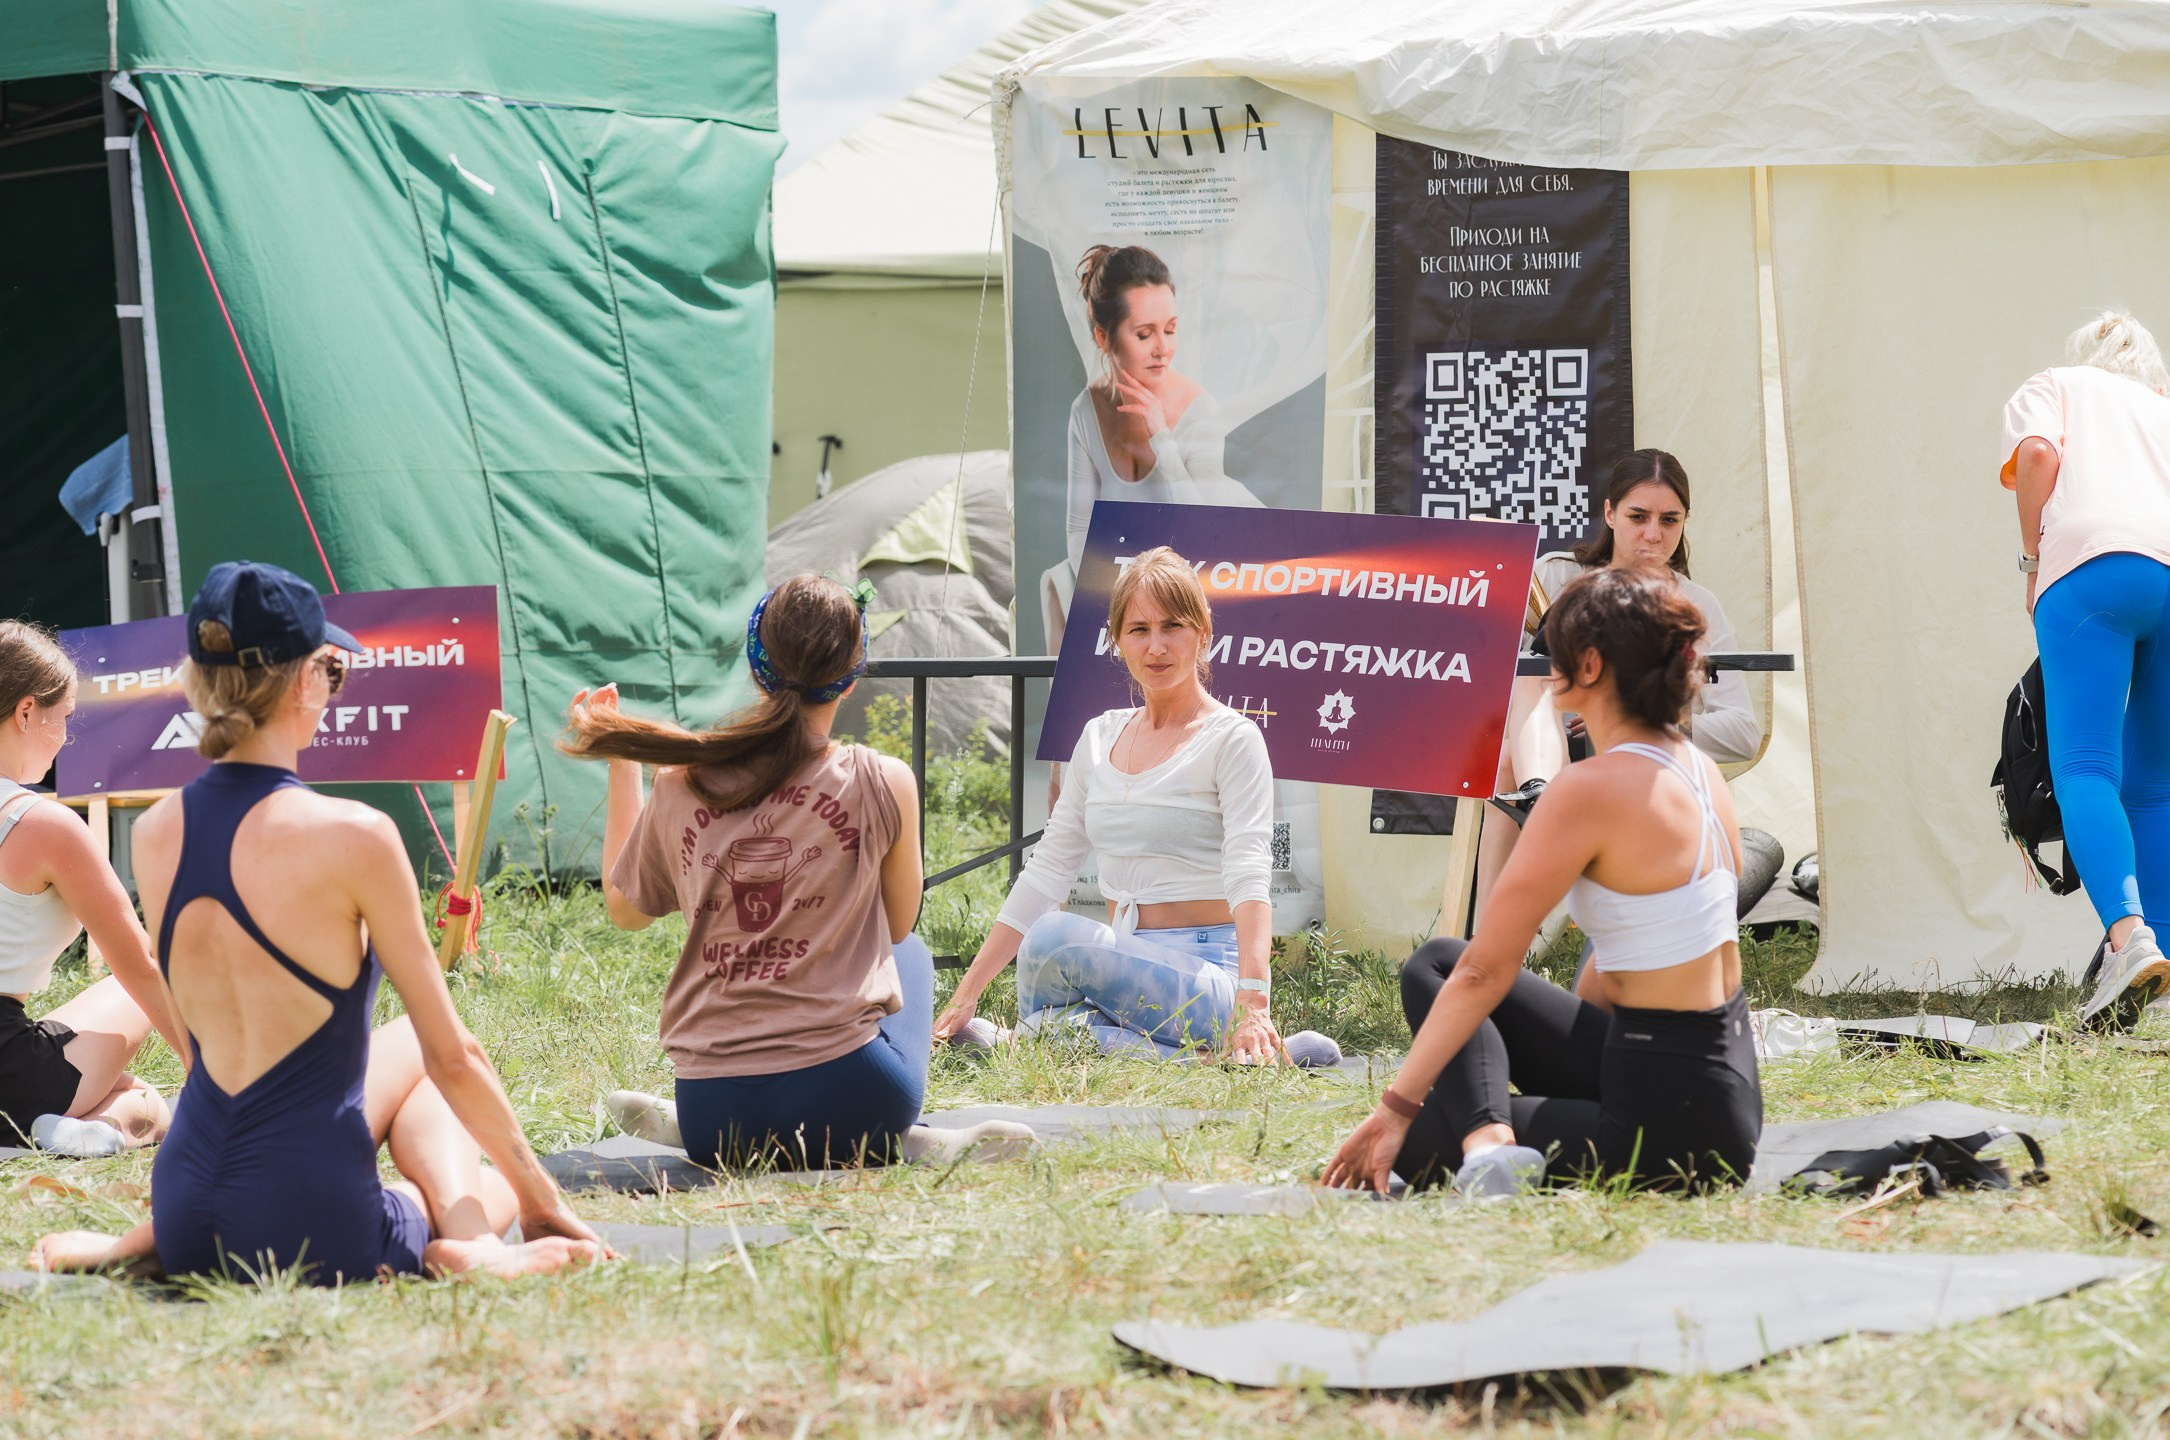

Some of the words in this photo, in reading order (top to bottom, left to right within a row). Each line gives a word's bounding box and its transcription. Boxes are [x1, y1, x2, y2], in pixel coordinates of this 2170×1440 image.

[1075, 103, 1268, 159] LEVITA
[1149, 169, 1200, 177] международная
[1107, 179, 1131, 188] студий
[1161, 179, 1193, 187] растяжки
[1136, 188, 1161, 196] каждой
[1162, 188, 1190, 196] девушки
[1427, 177, 1488, 196] ВРЕМЕНИ
[1495, 175, 1523, 195] ДЛЯ
[1530, 174, 1574, 192] СЕБЯ.
[1167, 198, 1212, 206] прикоснуться
[1111, 210, 1147, 218] исполнить
[1530, 227, 1550, 244] НА
[1420, 253, 1513, 273] БЕСПЛАТНОЕ
[1522, 251, 1582, 270] ЗАНЯТИЕ
[1450, 280, 1473, 298] ПО
[1480, 278, 1552, 297] РАСТЯЖКЕ
[1209, 561, 1490, 608] СПОРТИВНЫЙ
[1238, 636, 1472, 683] РАСТЯЖКА
